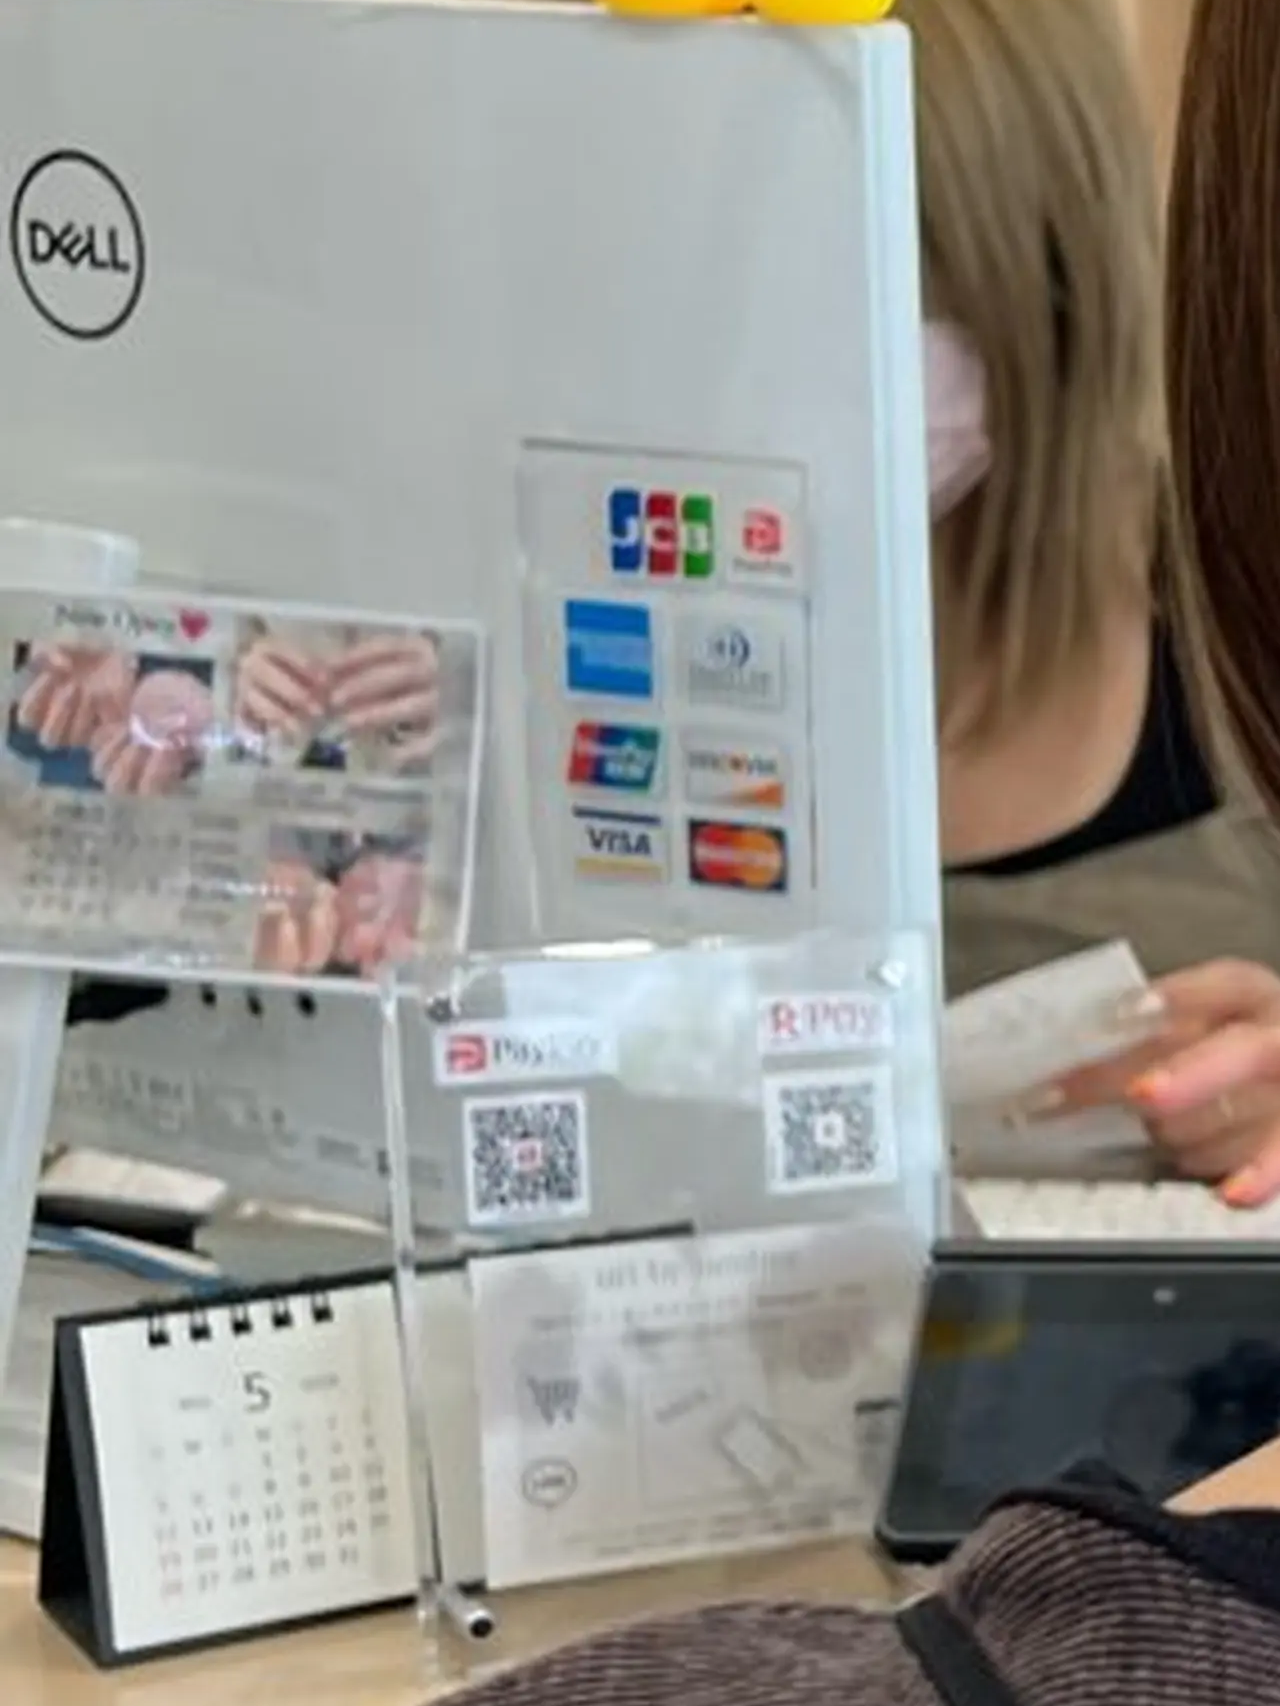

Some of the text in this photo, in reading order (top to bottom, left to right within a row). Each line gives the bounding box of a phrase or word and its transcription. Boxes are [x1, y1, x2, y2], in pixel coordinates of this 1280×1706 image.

[29, 219, 130, 273] DELL
[588, 825, 651, 857] VISA
[243, 1370, 271, 1413] 5
